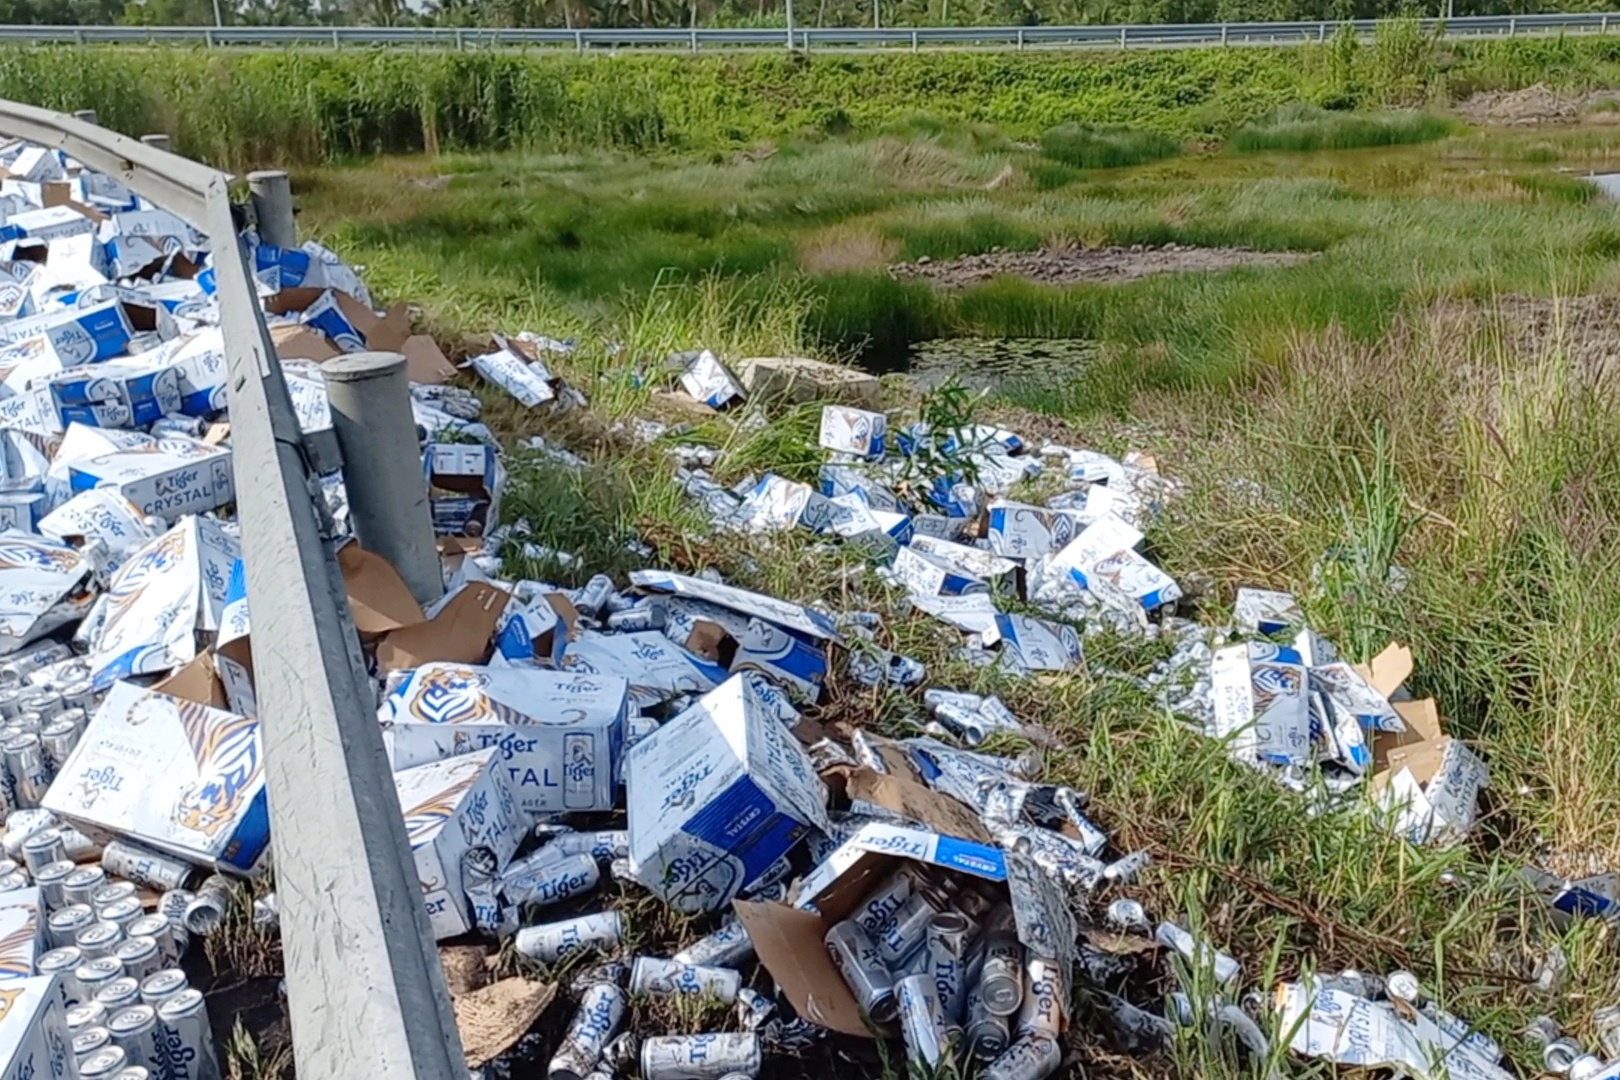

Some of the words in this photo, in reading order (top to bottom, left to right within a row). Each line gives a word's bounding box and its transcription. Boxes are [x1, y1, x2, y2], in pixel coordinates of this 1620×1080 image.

[166, 470, 198, 489] Tiger
[143, 486, 212, 515] CRYSTAL
[477, 732, 538, 760] Tiger
[80, 765, 124, 792] Tiger
[725, 807, 761, 837] CRYSTAL
[860, 835, 923, 855] Tiger
[952, 855, 997, 873] CRYSTAL
[537, 872, 589, 901] Tiger
[863, 893, 906, 930] Tige
[575, 991, 614, 1042] Tiger
